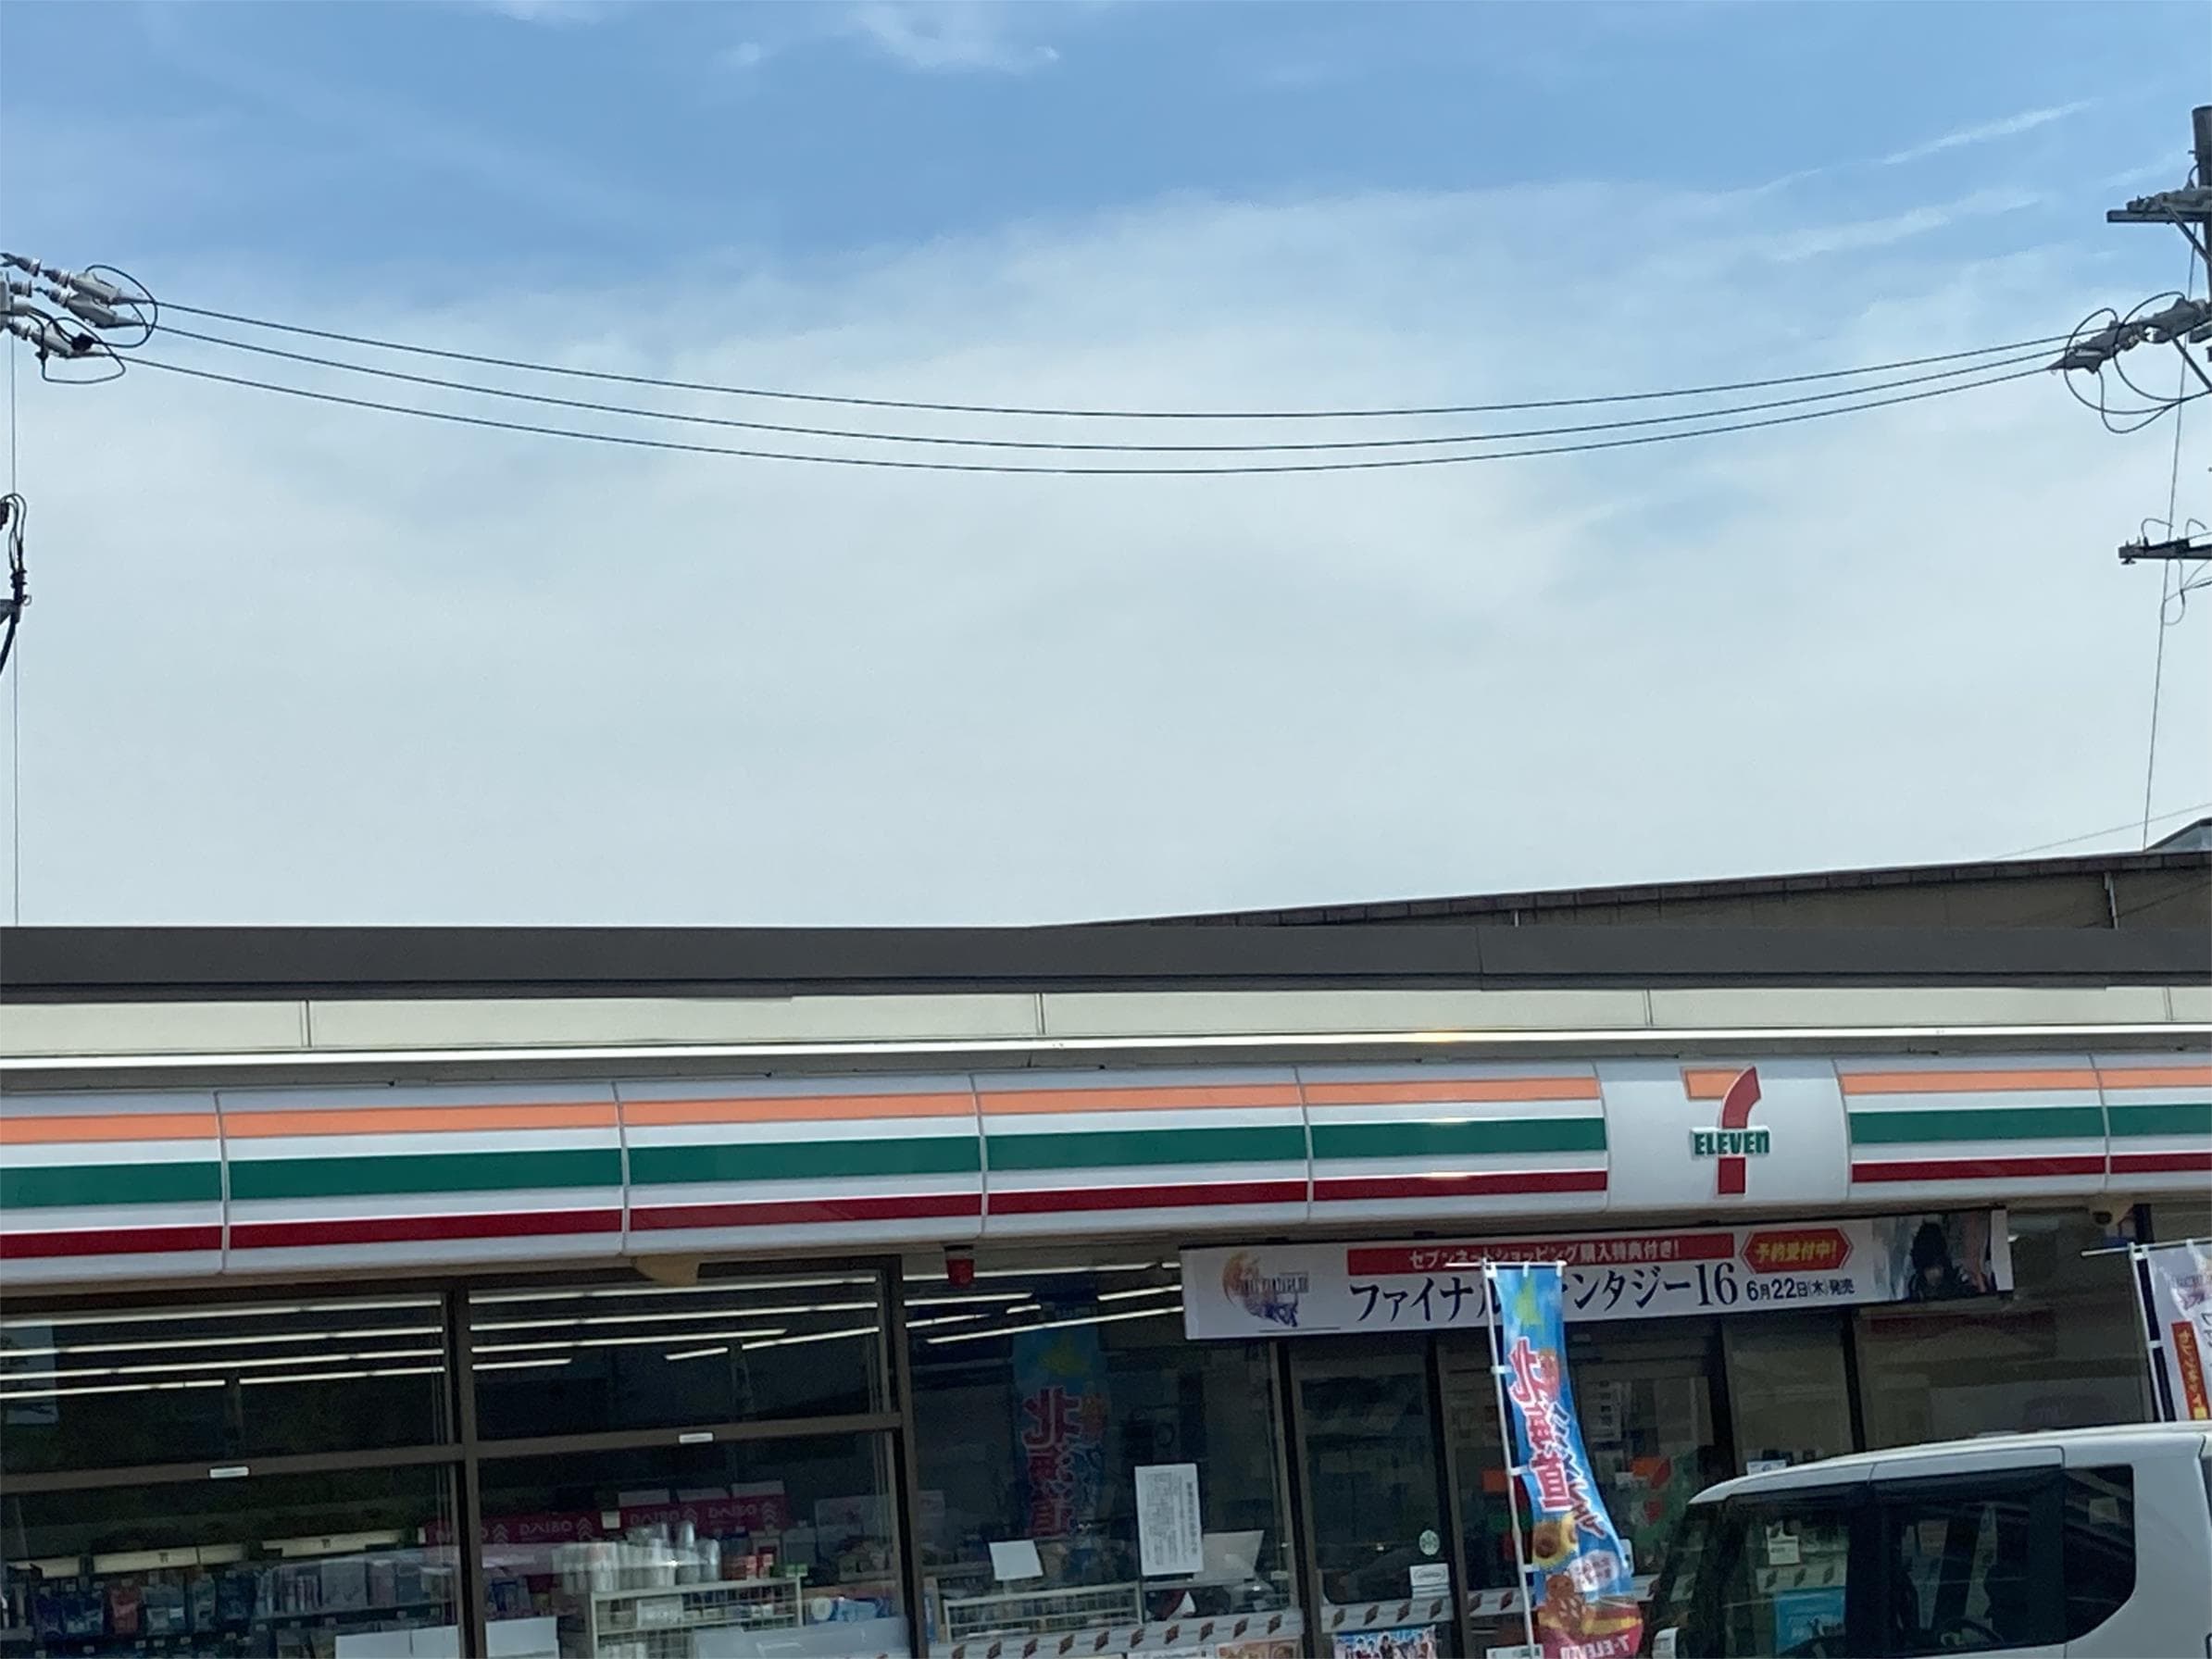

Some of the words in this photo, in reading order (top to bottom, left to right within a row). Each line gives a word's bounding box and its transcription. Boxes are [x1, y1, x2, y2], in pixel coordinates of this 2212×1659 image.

[1349, 1261, 1739, 1323] ファイナルンタジー16
